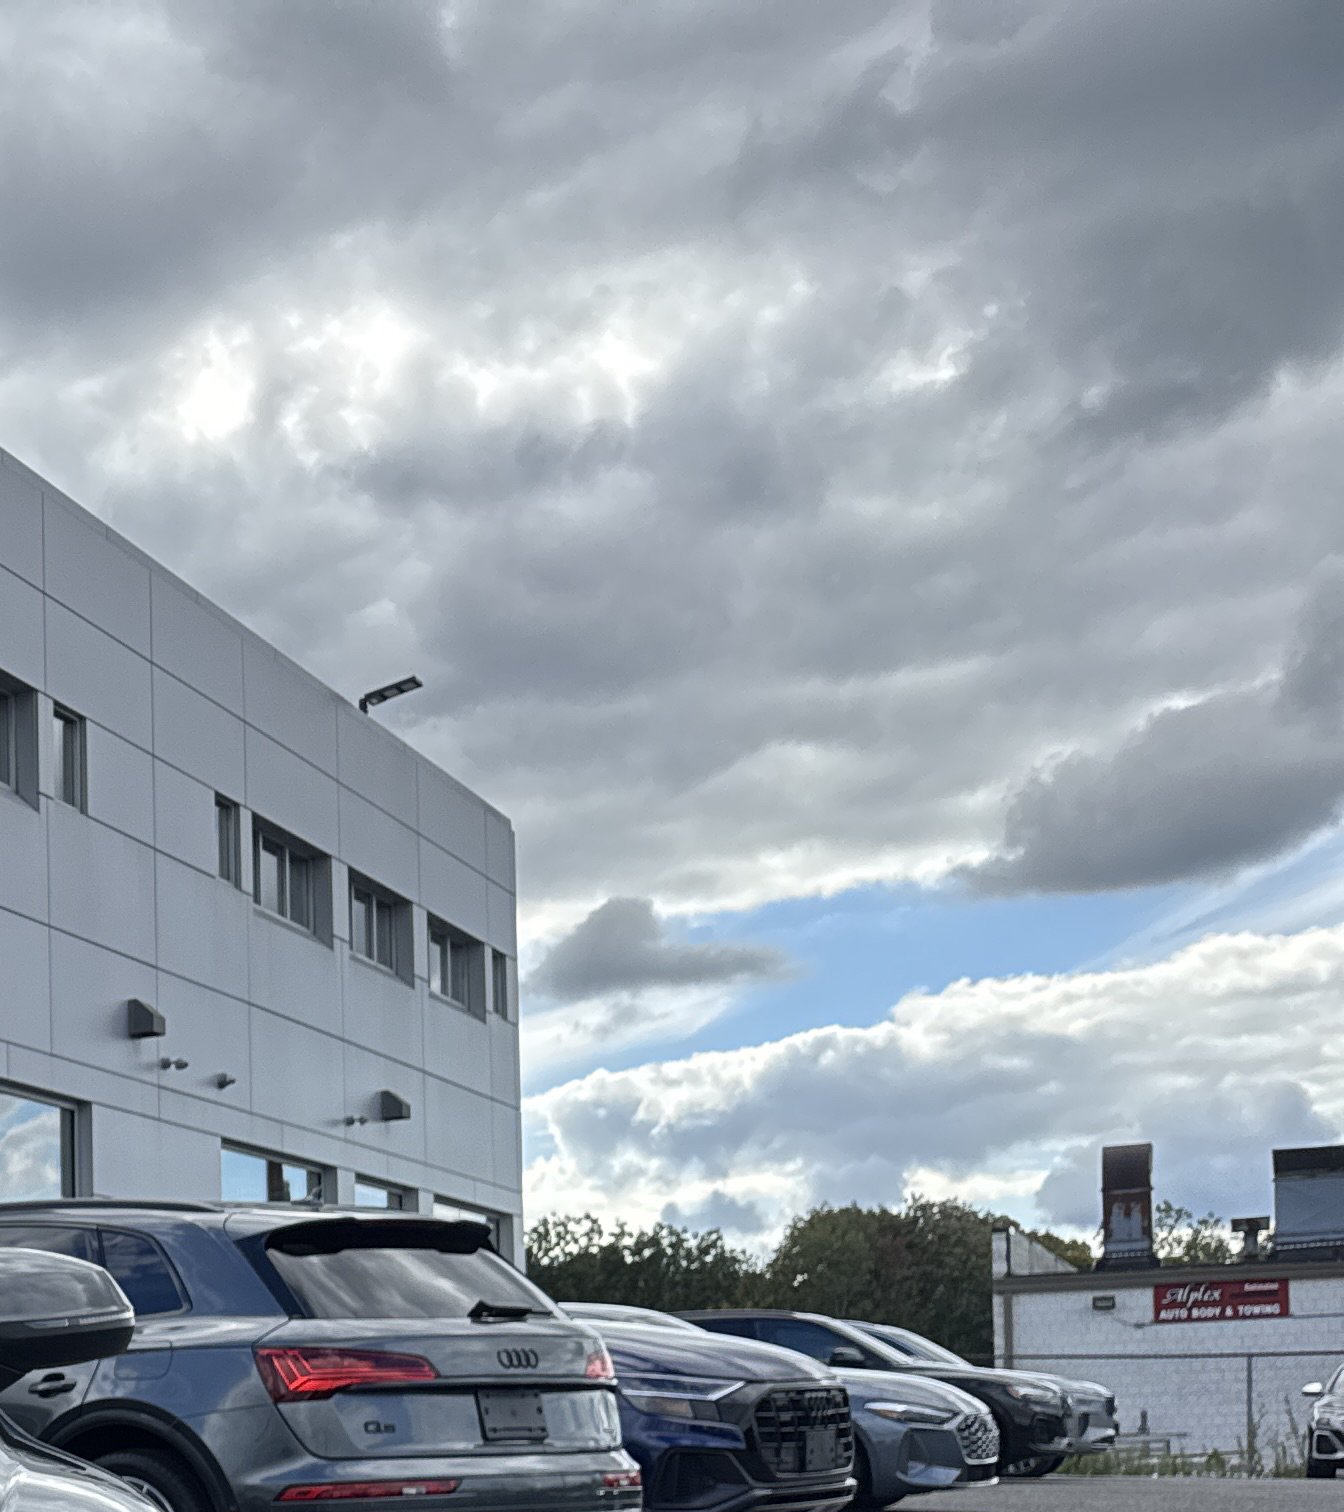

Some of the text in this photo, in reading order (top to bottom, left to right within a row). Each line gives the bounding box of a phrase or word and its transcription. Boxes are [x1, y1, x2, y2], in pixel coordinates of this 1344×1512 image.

[1158, 1302, 1281, 1320] AUTO BODY & TOWING
